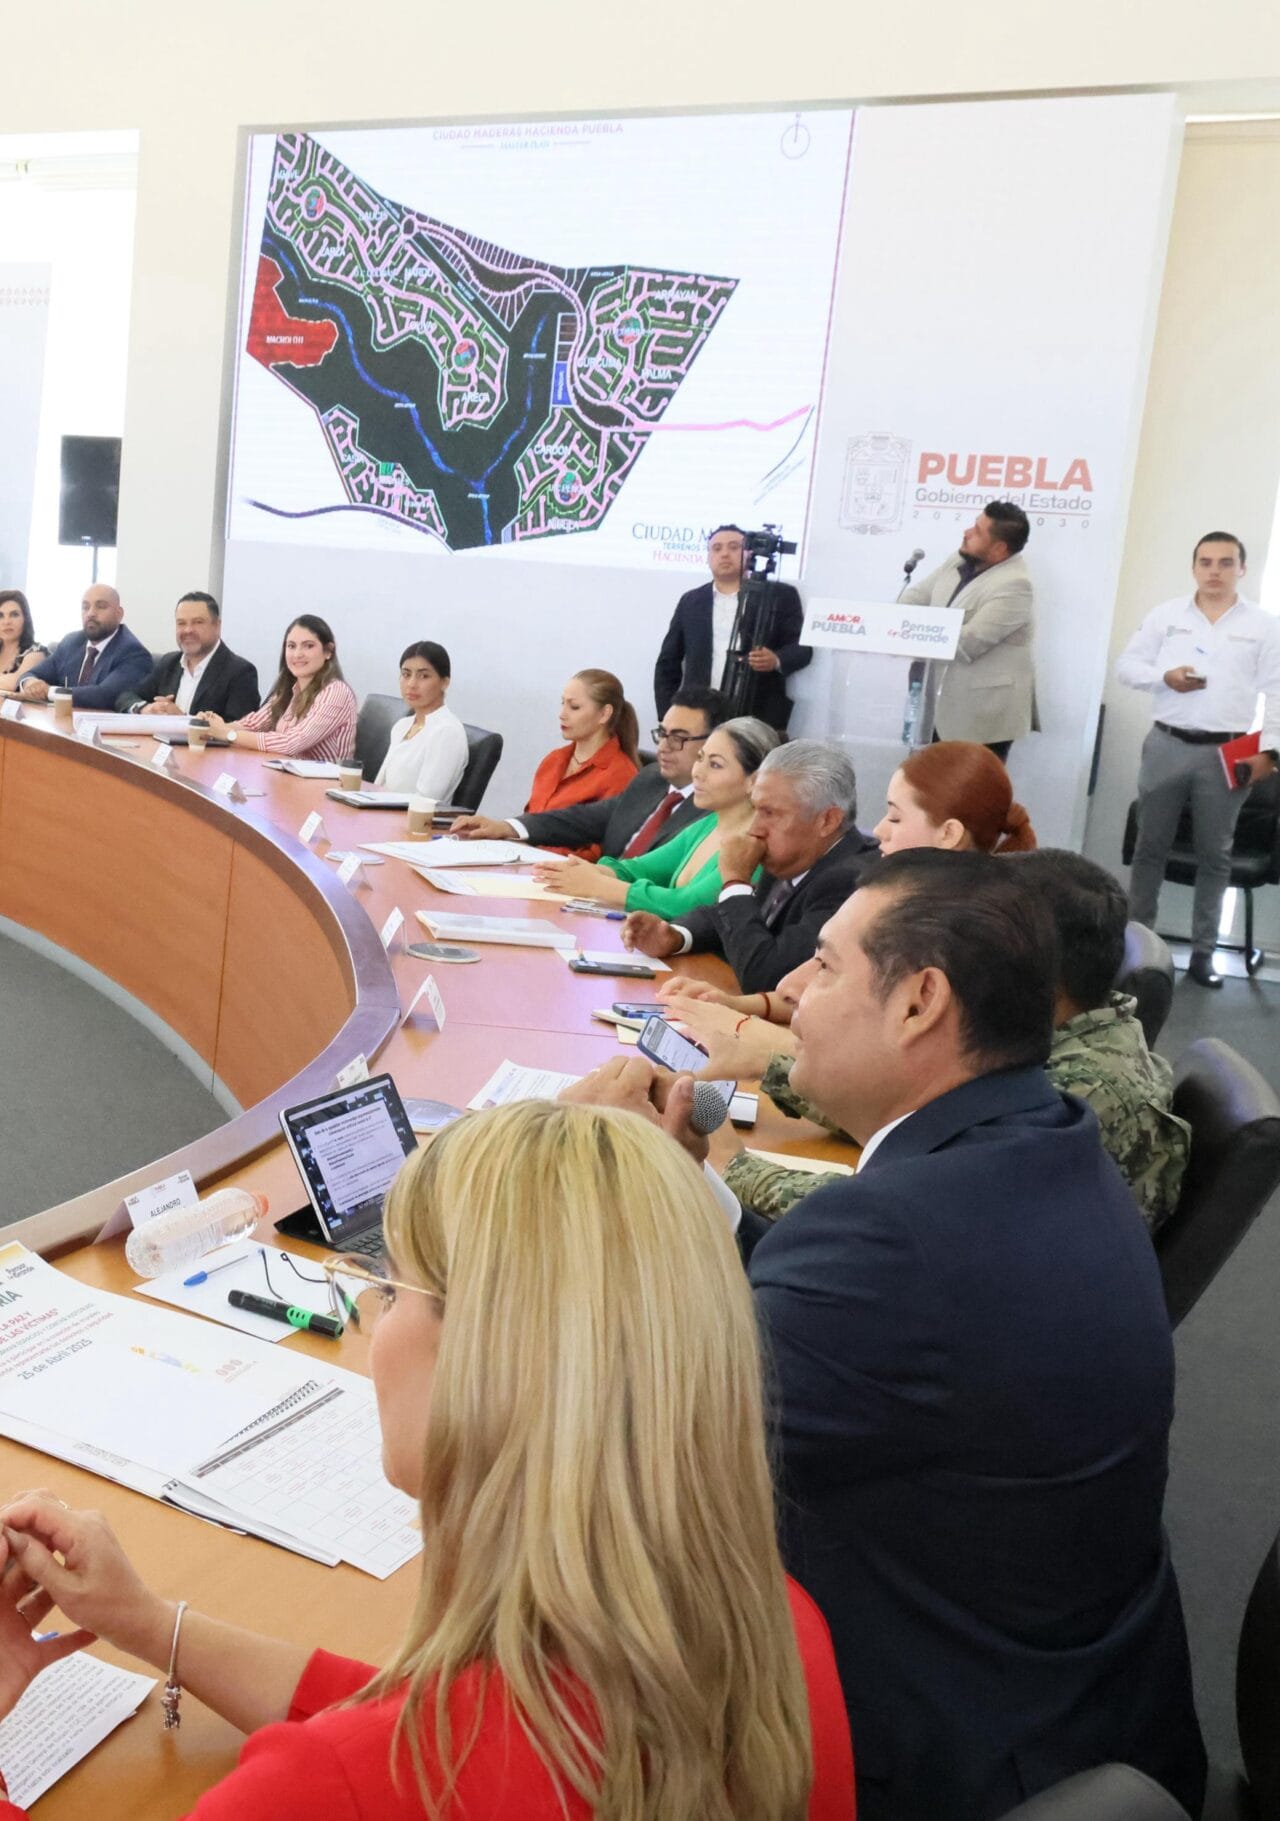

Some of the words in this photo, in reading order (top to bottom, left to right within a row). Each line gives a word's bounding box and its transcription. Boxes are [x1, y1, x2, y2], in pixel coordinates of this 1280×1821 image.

[917, 452, 1093, 492] PUEBLA
[915, 487, 996, 505] Gobierno
[1029, 494, 1093, 511] Estado
[631, 522, 694, 541] CIUDAD
[811, 620, 867, 636] PUEBLA
[900, 620, 946, 634] Pensar
[900, 631, 949, 643] Grande
[150, 1197, 181, 1217] ALEJANDRO
[8, 1314, 27, 1328] PAZ
[5, 1326, 24, 1339] LAS
[33, 1363, 48, 1374] de
[45, 1351, 68, 1367] Abril
